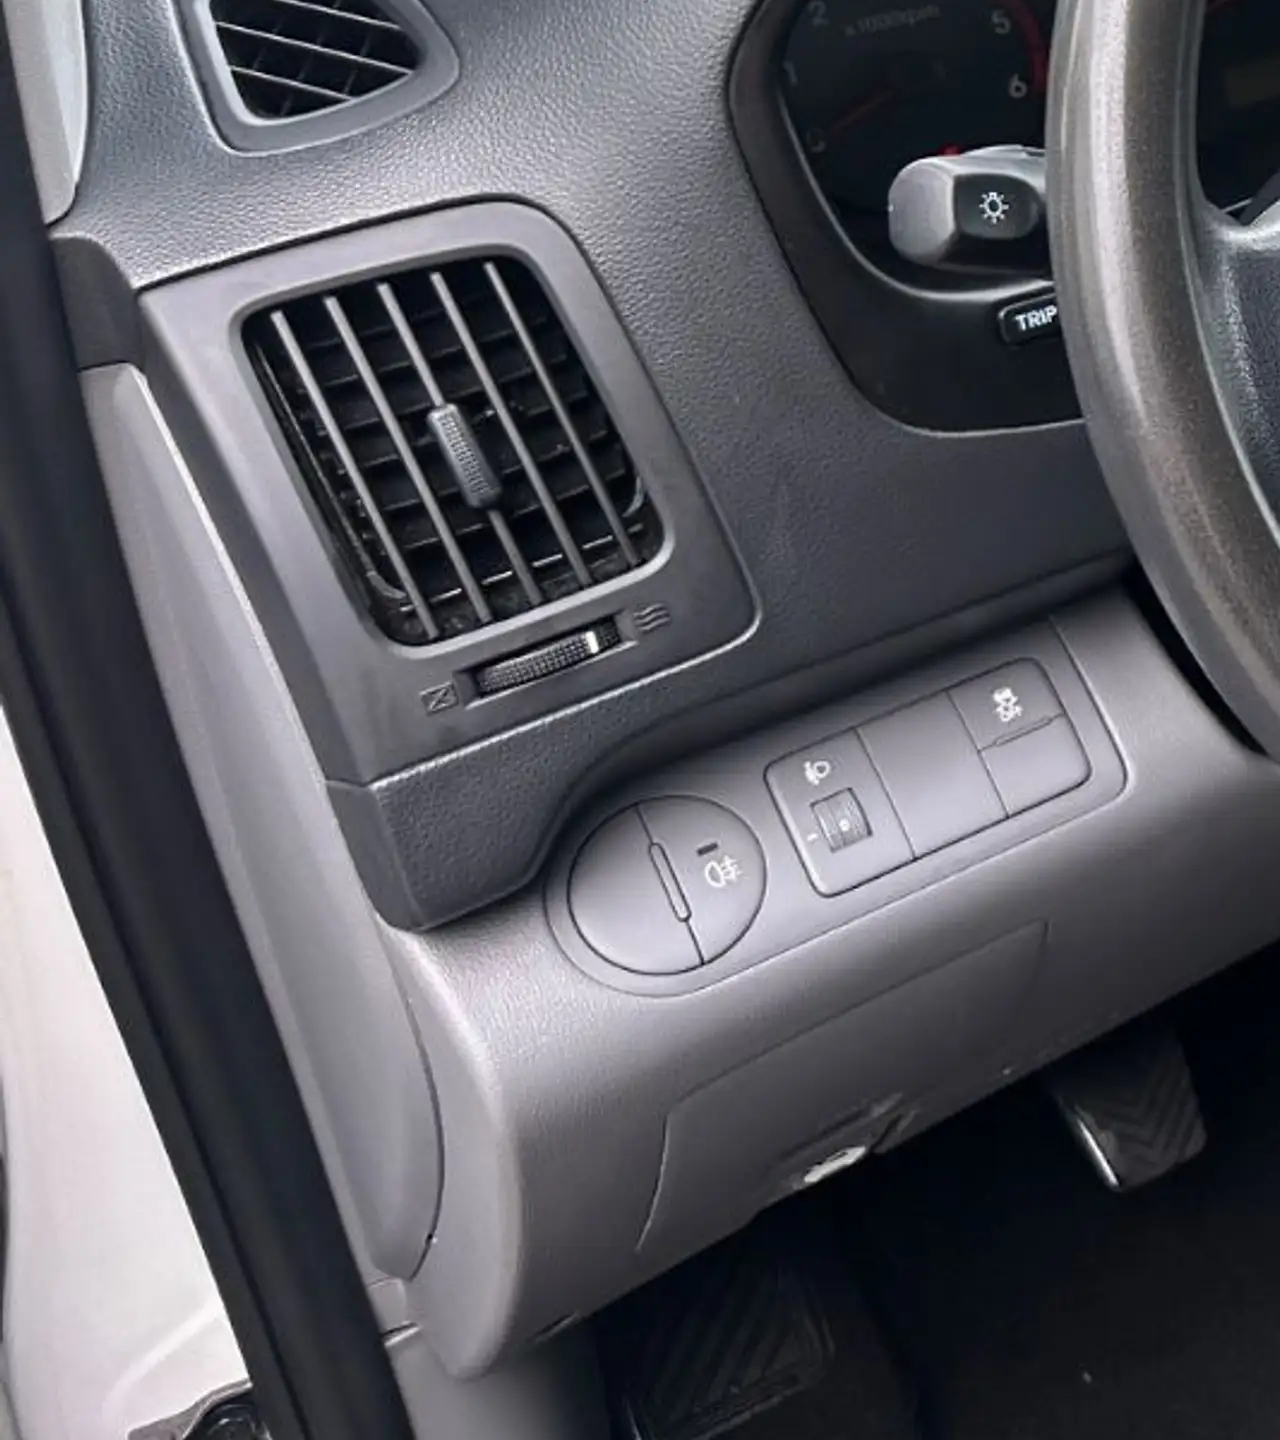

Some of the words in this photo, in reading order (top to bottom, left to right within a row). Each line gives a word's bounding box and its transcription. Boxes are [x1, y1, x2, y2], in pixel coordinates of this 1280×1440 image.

[808, 0, 829, 27] 2
[990, 9, 1012, 35] 5
[1007, 73, 1028, 98] 6
[1014, 304, 1058, 332] TRIP
